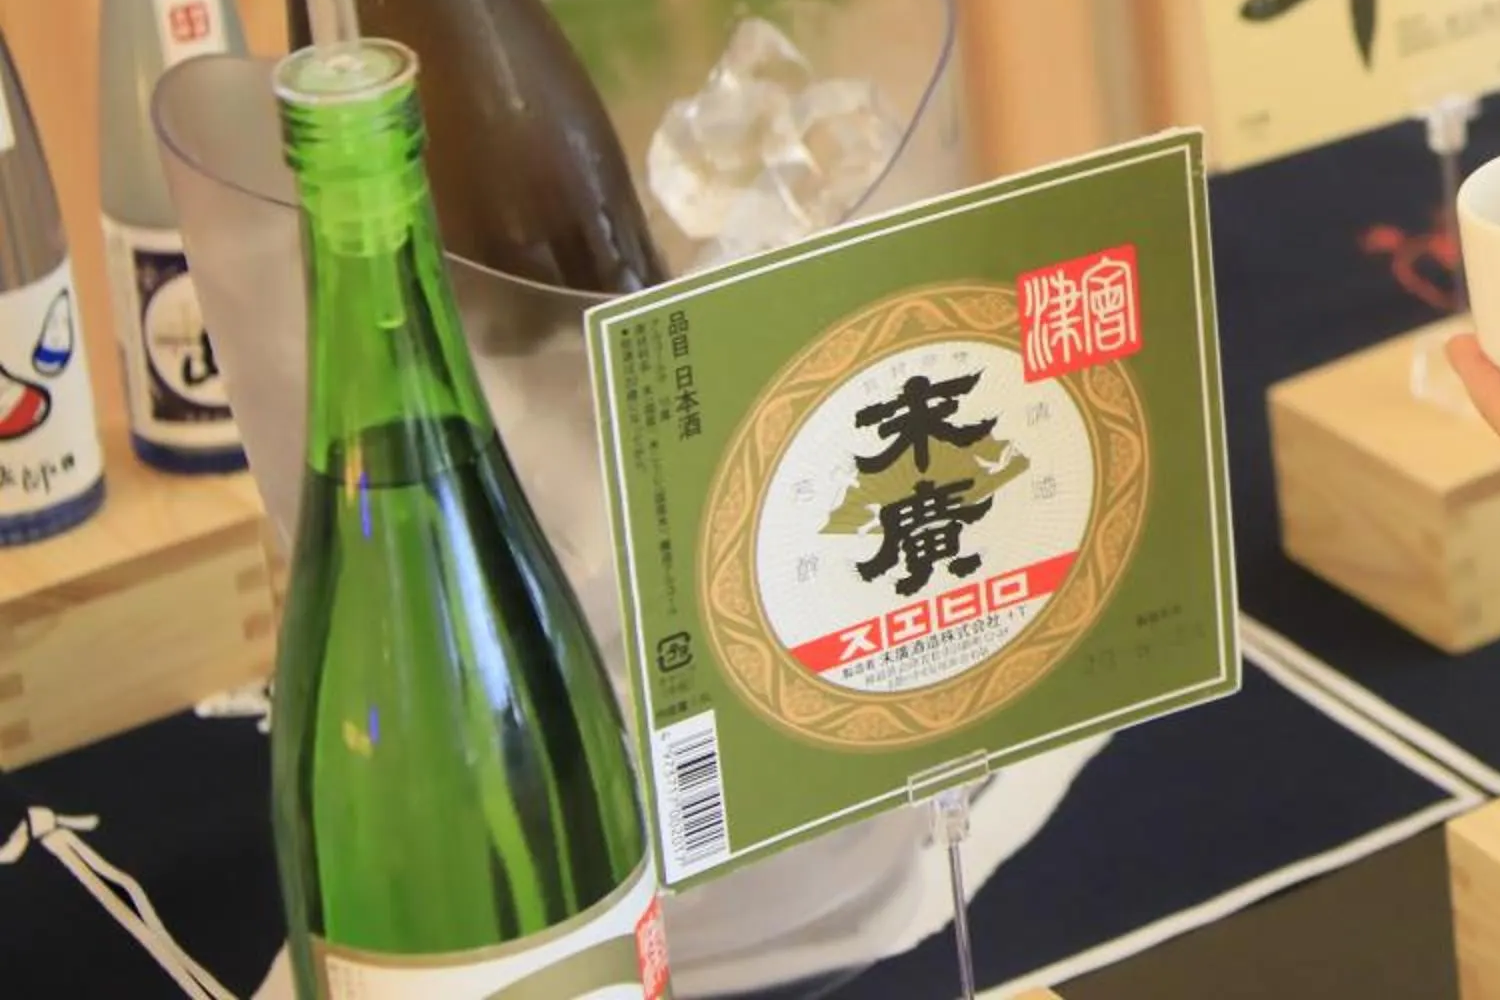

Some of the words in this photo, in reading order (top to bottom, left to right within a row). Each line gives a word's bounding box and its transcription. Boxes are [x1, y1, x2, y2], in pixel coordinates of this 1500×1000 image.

[668, 310, 689, 360] 品目
[675, 365, 702, 442] 日本酒
[854, 366, 999, 597] 末廣
[838, 570, 1029, 661] スエヒロ
